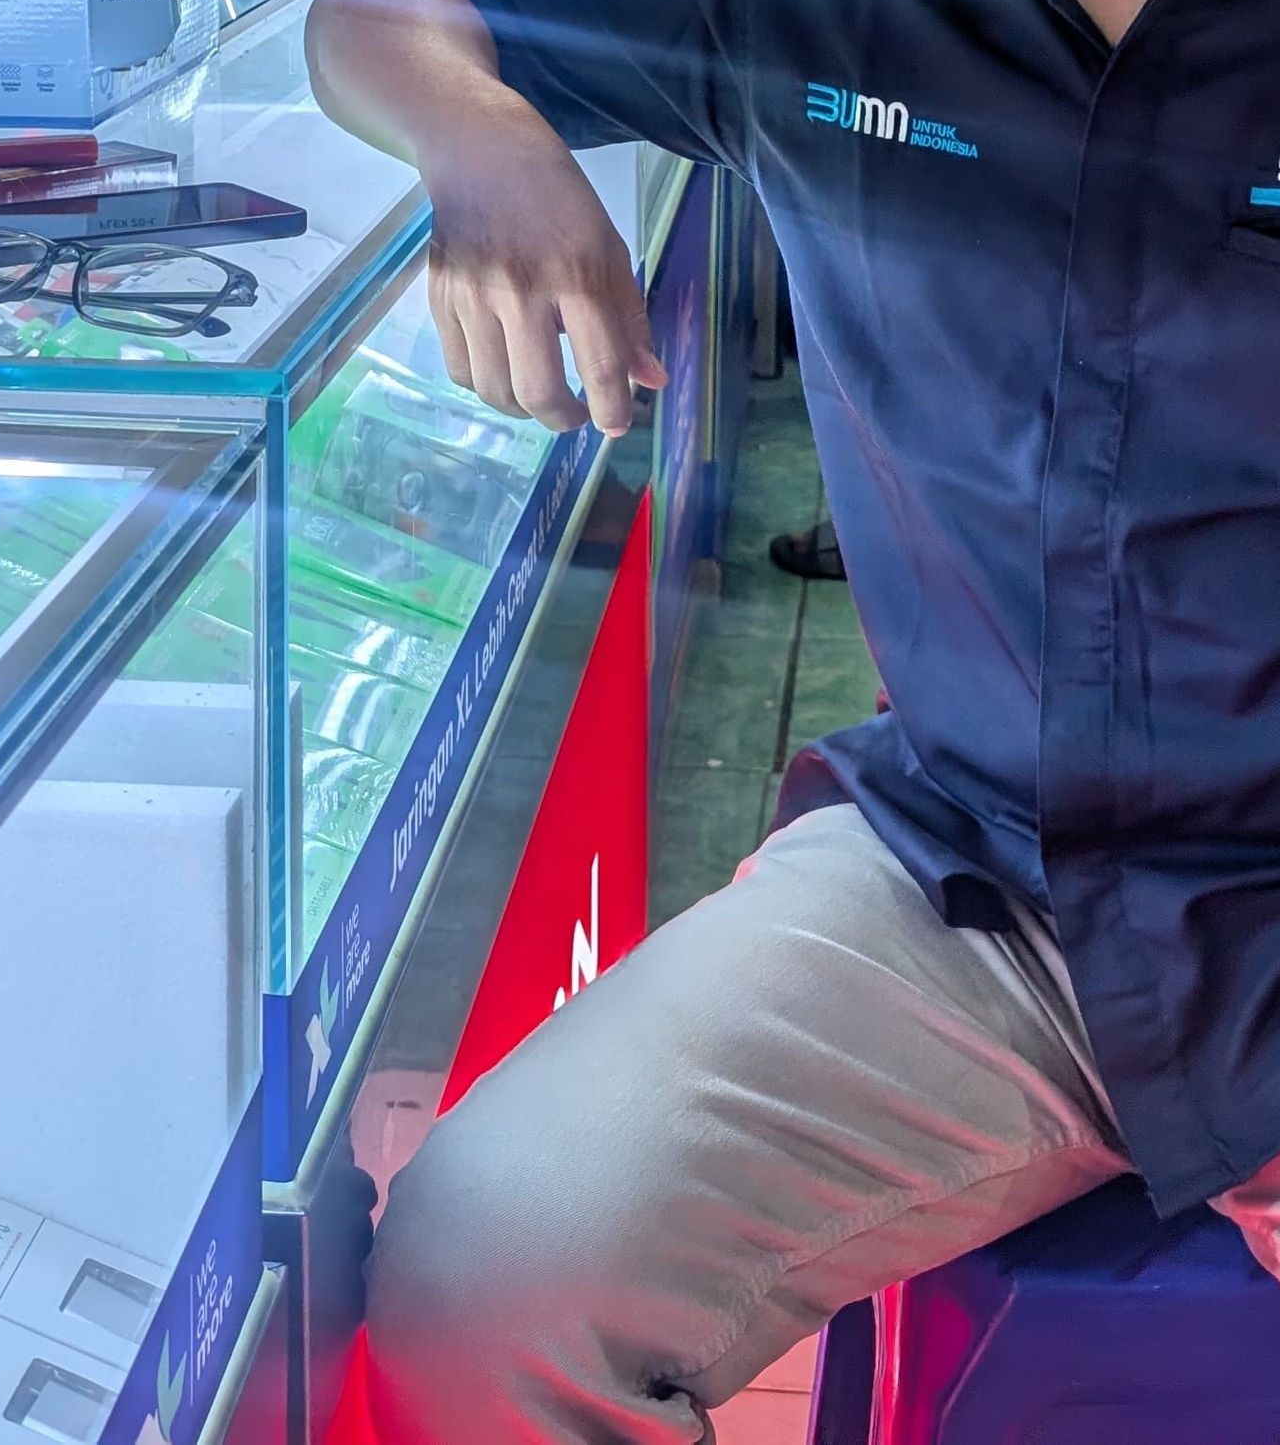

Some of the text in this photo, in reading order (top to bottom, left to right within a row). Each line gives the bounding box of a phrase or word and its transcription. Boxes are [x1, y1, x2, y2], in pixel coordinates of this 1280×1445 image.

[910, 132, 978, 159] INDONESIA
[912, 118, 958, 140] UNTUK
[389, 719, 455, 893] Jaringan
[455, 671, 473, 744] XL
[474, 597, 507, 699] Lebih
[506, 526, 539, 622] Cepat
[345, 903, 359, 944] we
[346, 933, 361, 978] are
[346, 940, 370, 1009] more
[195, 1239, 217, 1298] we
[196, 1275, 218, 1340] are
[196, 1274, 233, 1381] more
